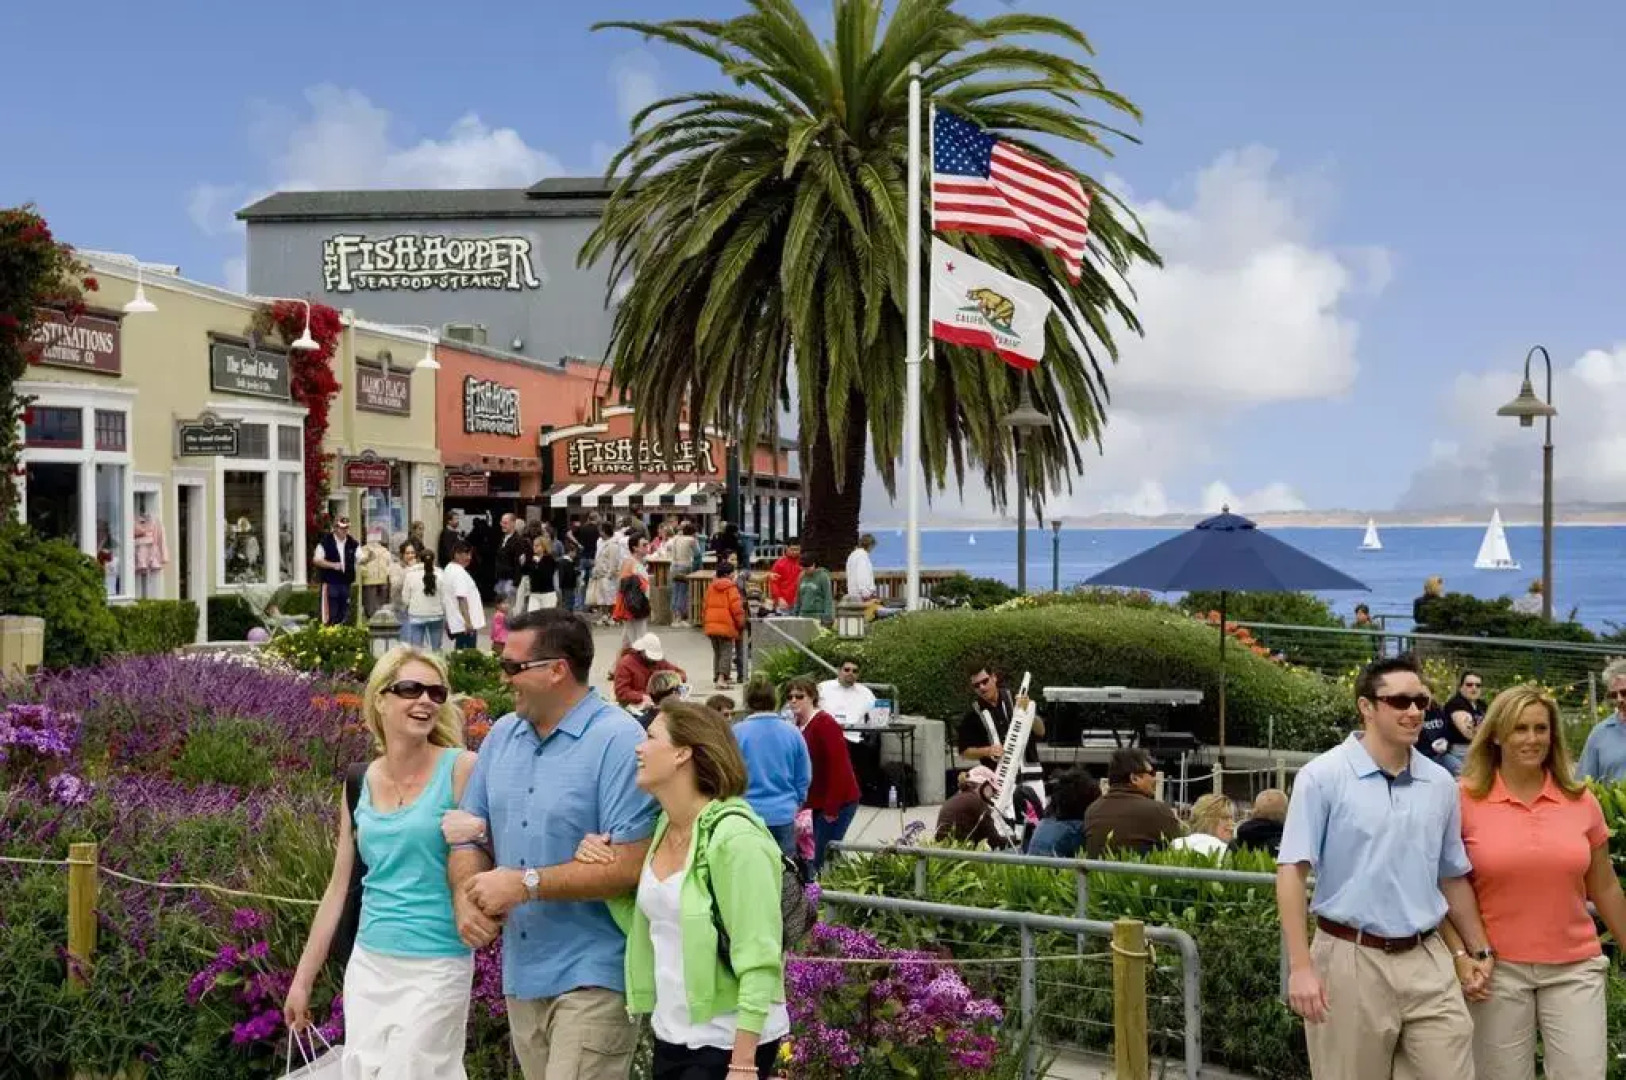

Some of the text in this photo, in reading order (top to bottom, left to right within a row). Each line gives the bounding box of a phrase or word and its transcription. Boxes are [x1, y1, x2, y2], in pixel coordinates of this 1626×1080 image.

[324, 241, 339, 290] THE
[333, 235, 540, 291] FISH HOPPER
[31, 322, 114, 353] ESTINATIONS
[576, 439, 633, 475] FISH
